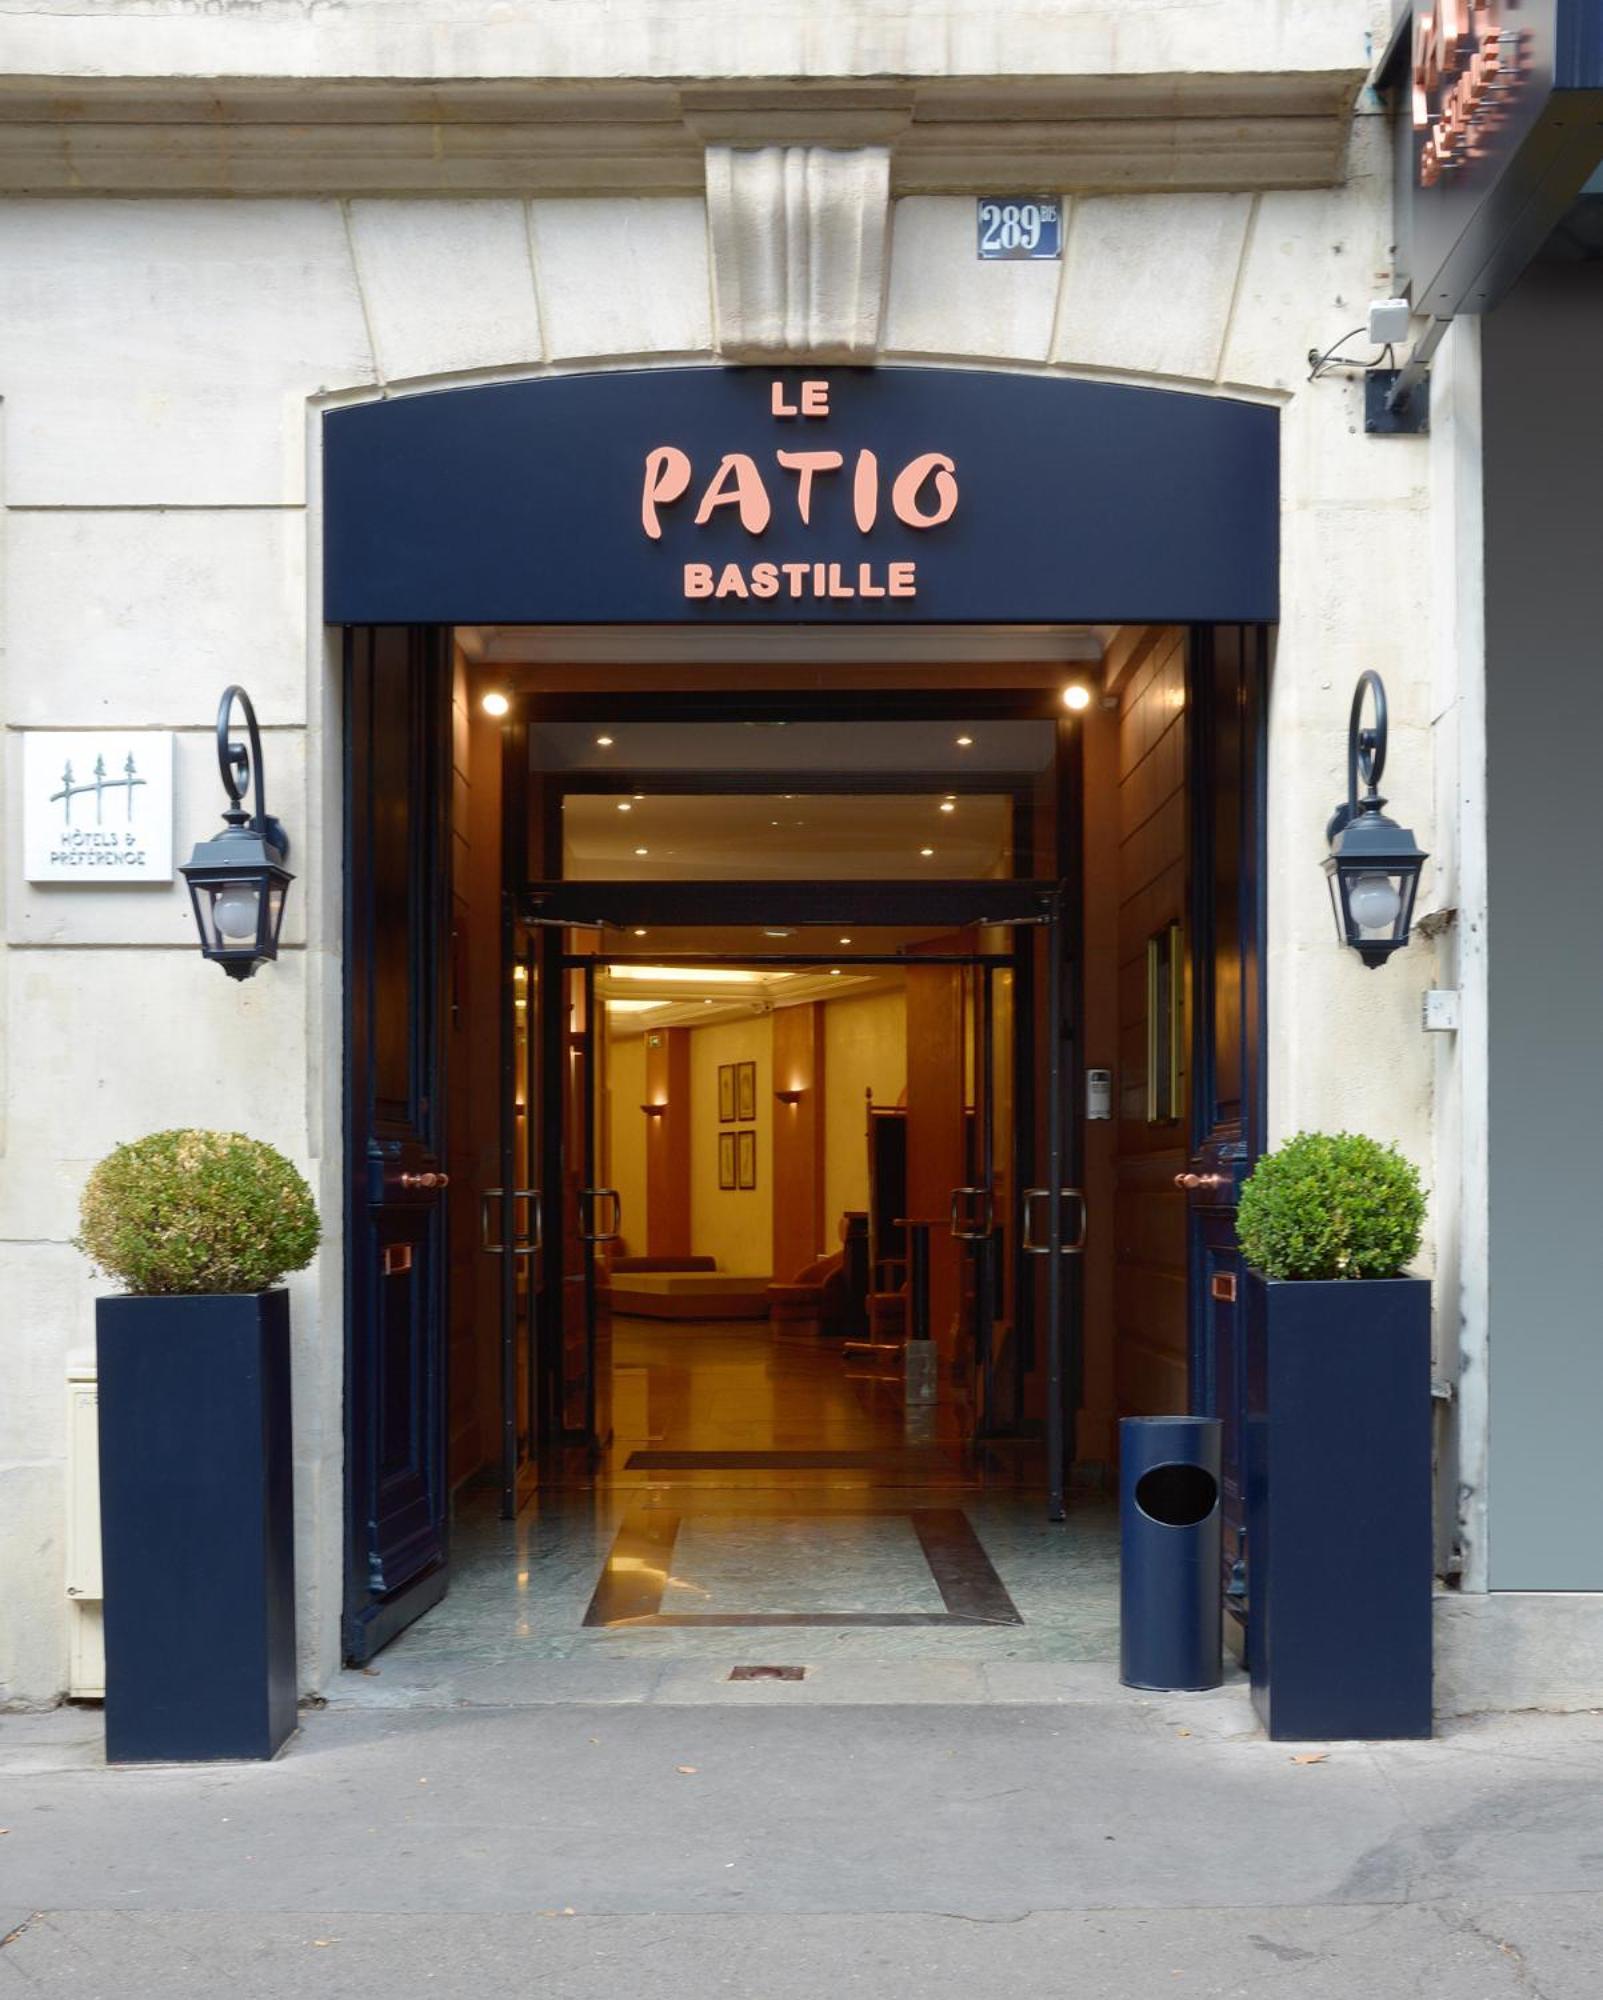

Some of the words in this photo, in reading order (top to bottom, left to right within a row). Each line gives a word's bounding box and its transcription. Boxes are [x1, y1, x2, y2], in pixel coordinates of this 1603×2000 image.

[981, 205, 1041, 250] 289
[771, 381, 829, 416] LE
[642, 446, 958, 539] PATIO
[684, 562, 916, 598] BASTILLE
[61, 828, 118, 847] HÔTELS
